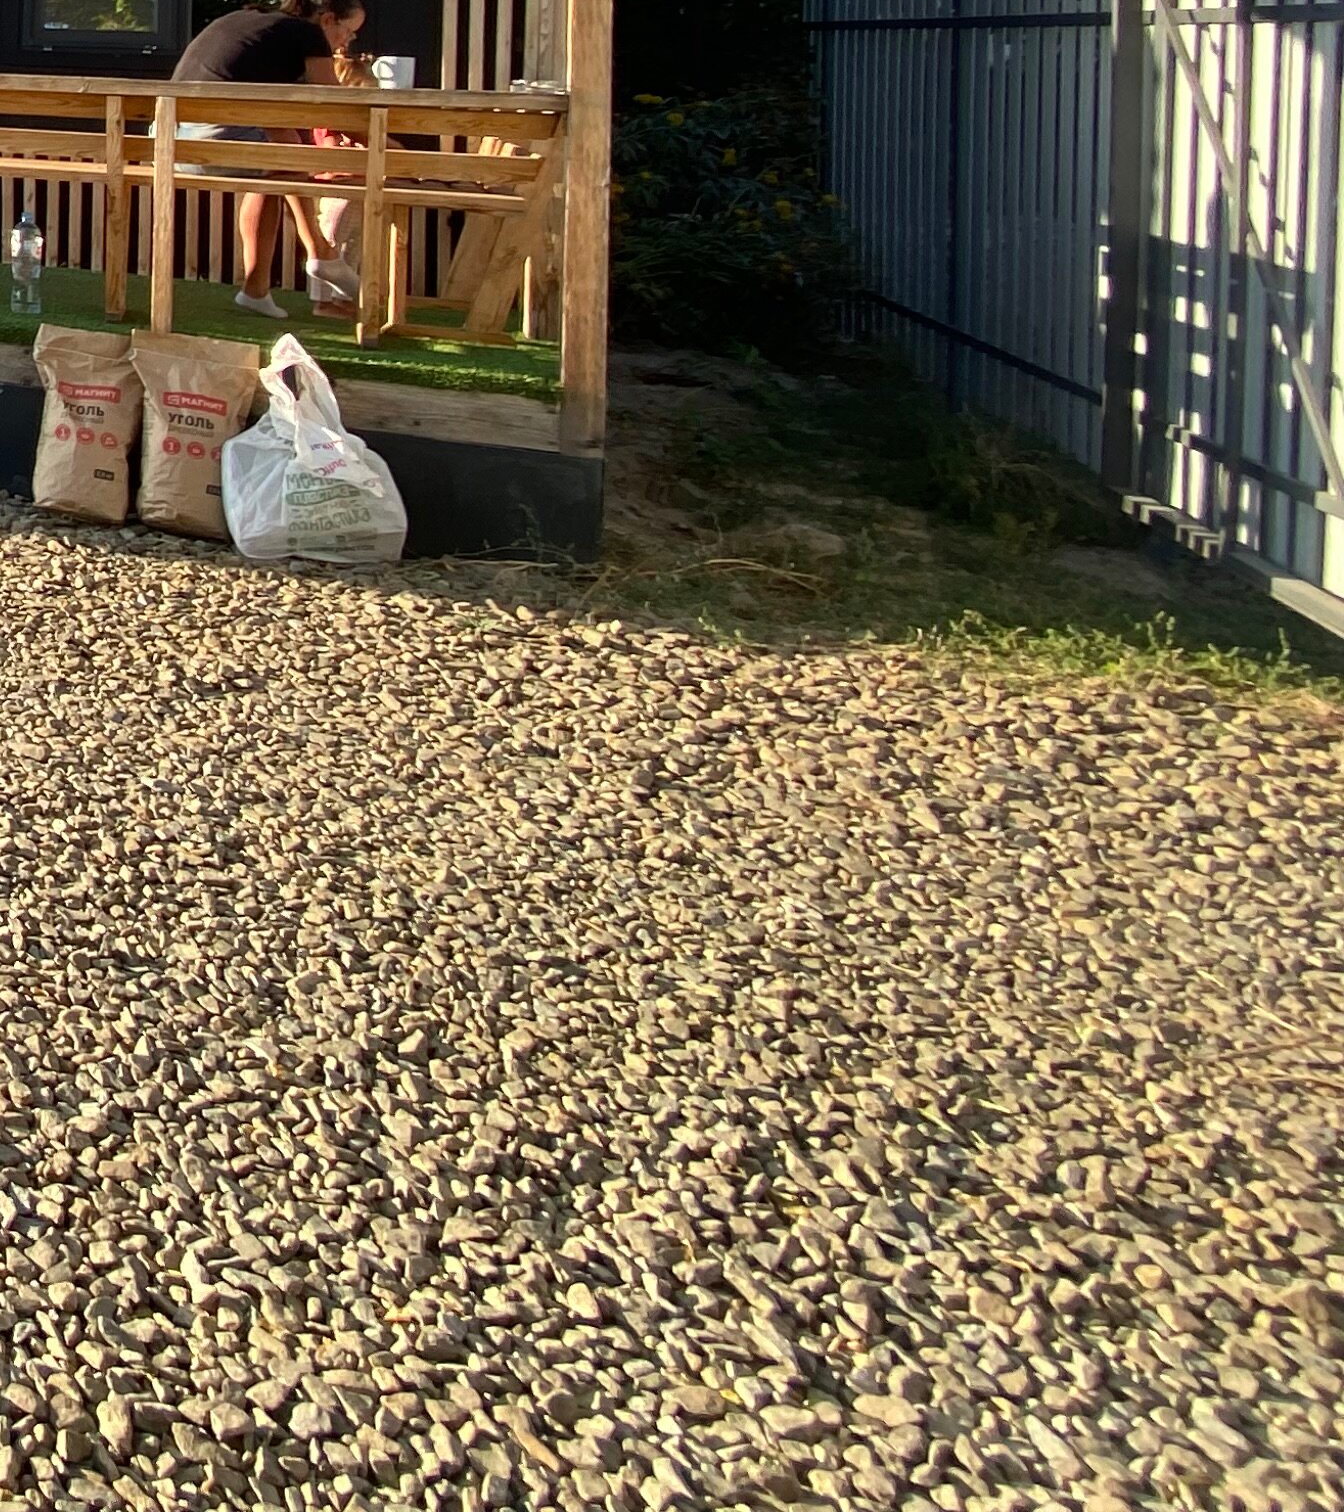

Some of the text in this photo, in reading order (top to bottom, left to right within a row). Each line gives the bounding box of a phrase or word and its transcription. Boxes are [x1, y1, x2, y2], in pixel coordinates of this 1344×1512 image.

[75, 388, 117, 399] МАГНИТ
[181, 396, 224, 411] МАГНИТ
[168, 412, 214, 429] УГОЛЬ
